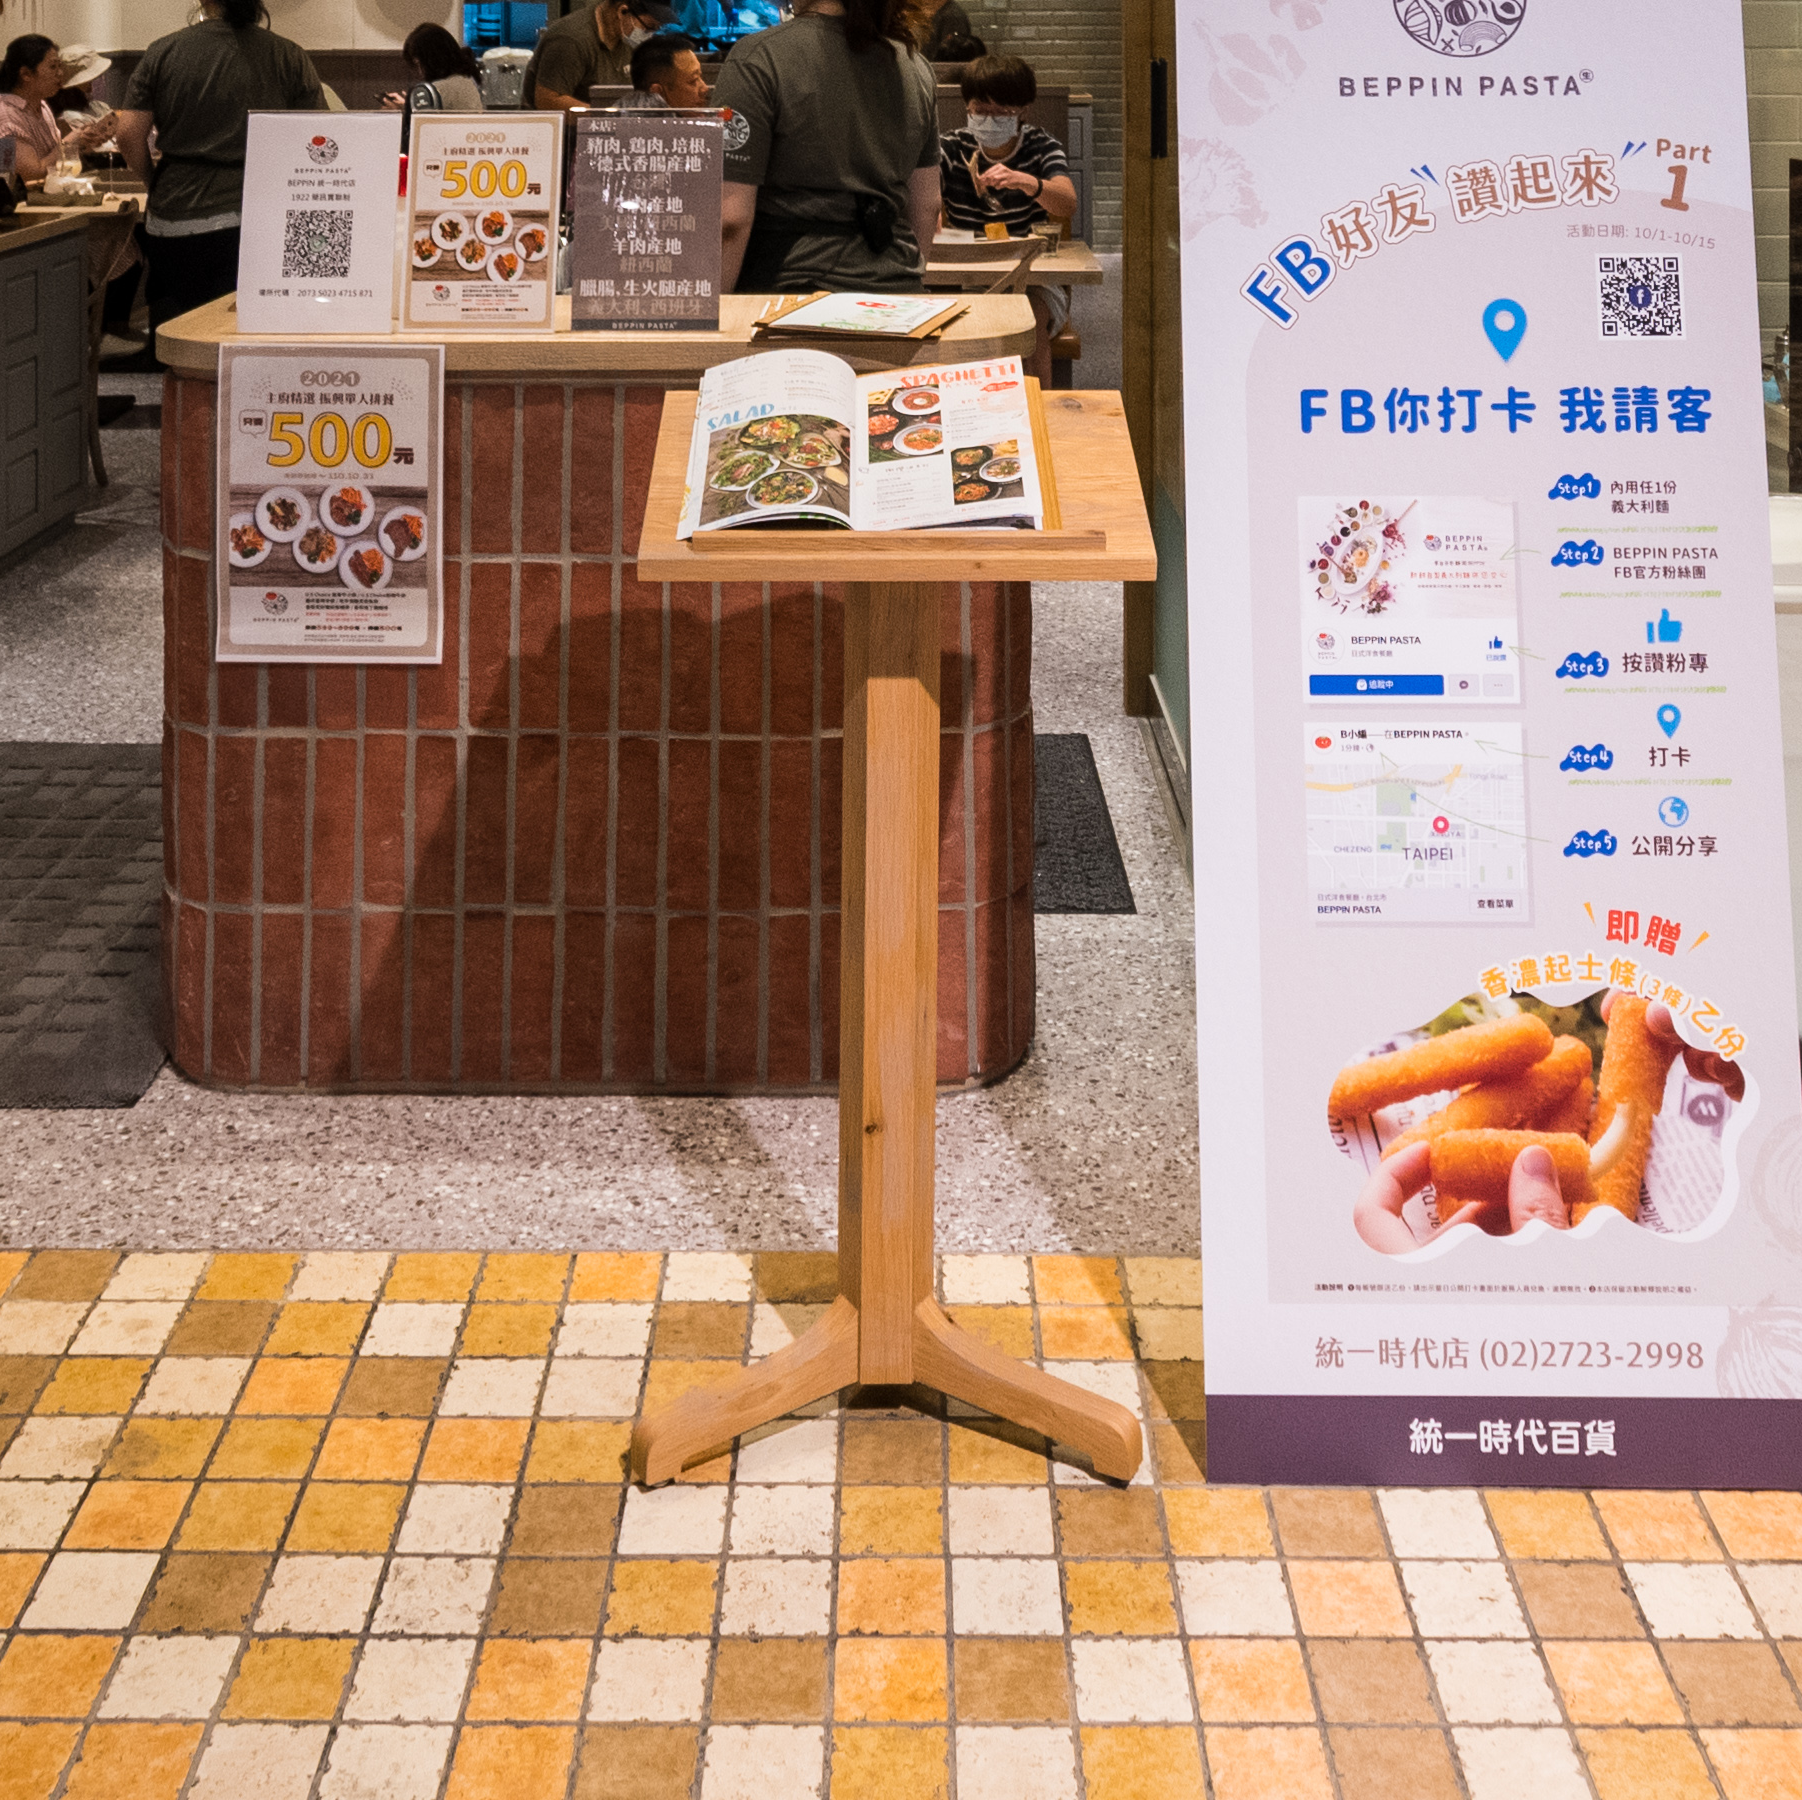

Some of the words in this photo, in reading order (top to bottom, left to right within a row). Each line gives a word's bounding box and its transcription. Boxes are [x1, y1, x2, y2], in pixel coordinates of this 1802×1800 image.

[1339, 76, 1462, 97] BEPPIN
[1479, 75, 1581, 96] PASTA
[1656, 138, 1712, 164] Part
[1660, 165, 1690, 212] 1
[1246, 188, 1430, 324] FB好友
[1452, 153, 1614, 214] 讚起來
[1634, 226, 1716, 250] 10/1-10/15
[300, 370, 360, 387] 2021
[900, 363, 1016, 389] SPAGHETTI
[707, 403, 775, 431] SALAD
[1300, 385, 1536, 434] FB你打卡
[1559, 385, 1712, 434] 我請客
[1611, 500, 1670, 514] 義大利麵
[1613, 547, 1667, 559] BEPPIN
[1672, 547, 1719, 559] PASTA
[1614, 565, 1706, 579] FB官方粉絲團
[1351, 636, 1387, 645] BEPPIN
[1390, 636, 1421, 645] PASTA
[1622, 652, 1709, 674] 按讚粉專
[1648, 746, 1691, 767] 打卡
[1402, 847, 1453, 860] TAIPEI
[1631, 835, 1718, 857] 公開分享
[1317, 905, 1350, 914] BEPPIN
[1352, 905, 1381, 914] PASTA
[1606, 909, 1682, 956] 即贈
[1315, 1337, 1469, 1369] 統一時代店
[1480, 1338, 1705, 1371] (02)2723-2998
[1409, 1417, 1617, 1456] 統一時代百貨
